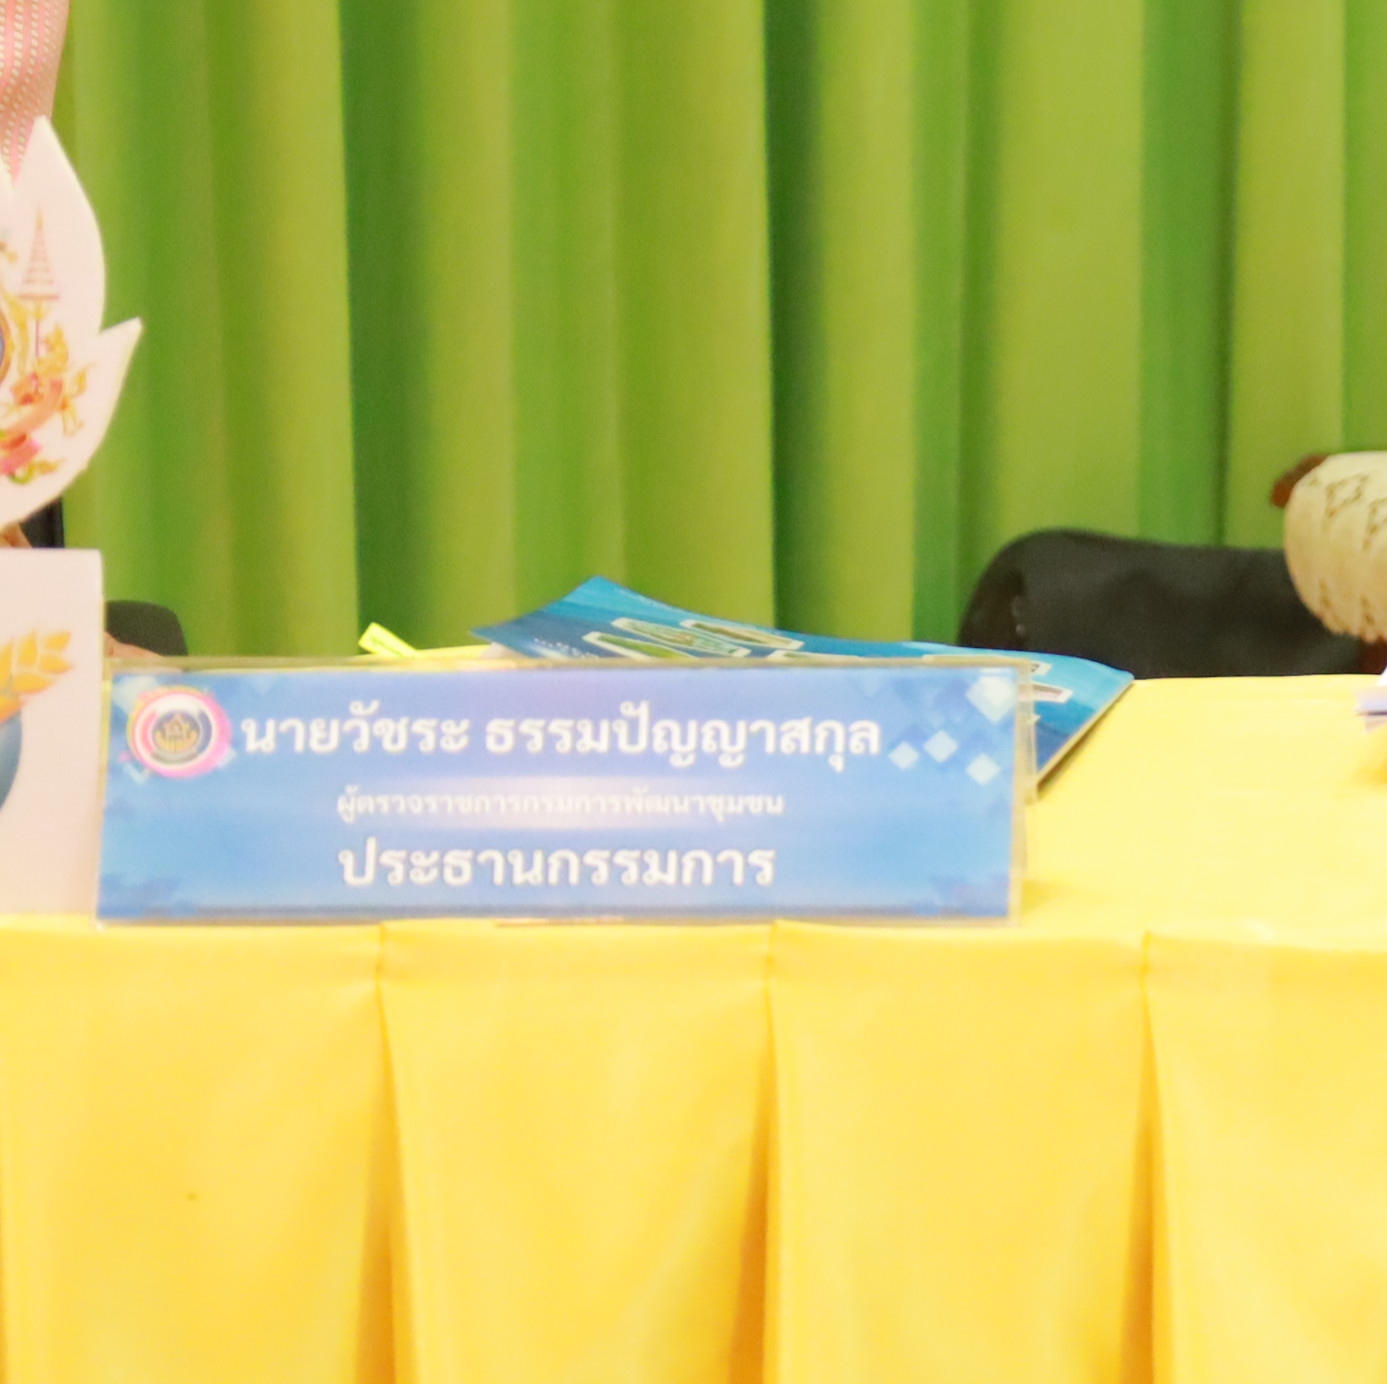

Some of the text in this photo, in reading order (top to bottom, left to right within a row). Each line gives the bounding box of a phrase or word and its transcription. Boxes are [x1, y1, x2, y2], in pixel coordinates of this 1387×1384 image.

[242, 699, 881, 771] นายวัชระ ธรรมปัญญาสกุล
[338, 785, 783, 822] ผู้ตรวจราชการกรมการพัฒนาชุมชน
[339, 836, 776, 888] ประธานกรรมการ
